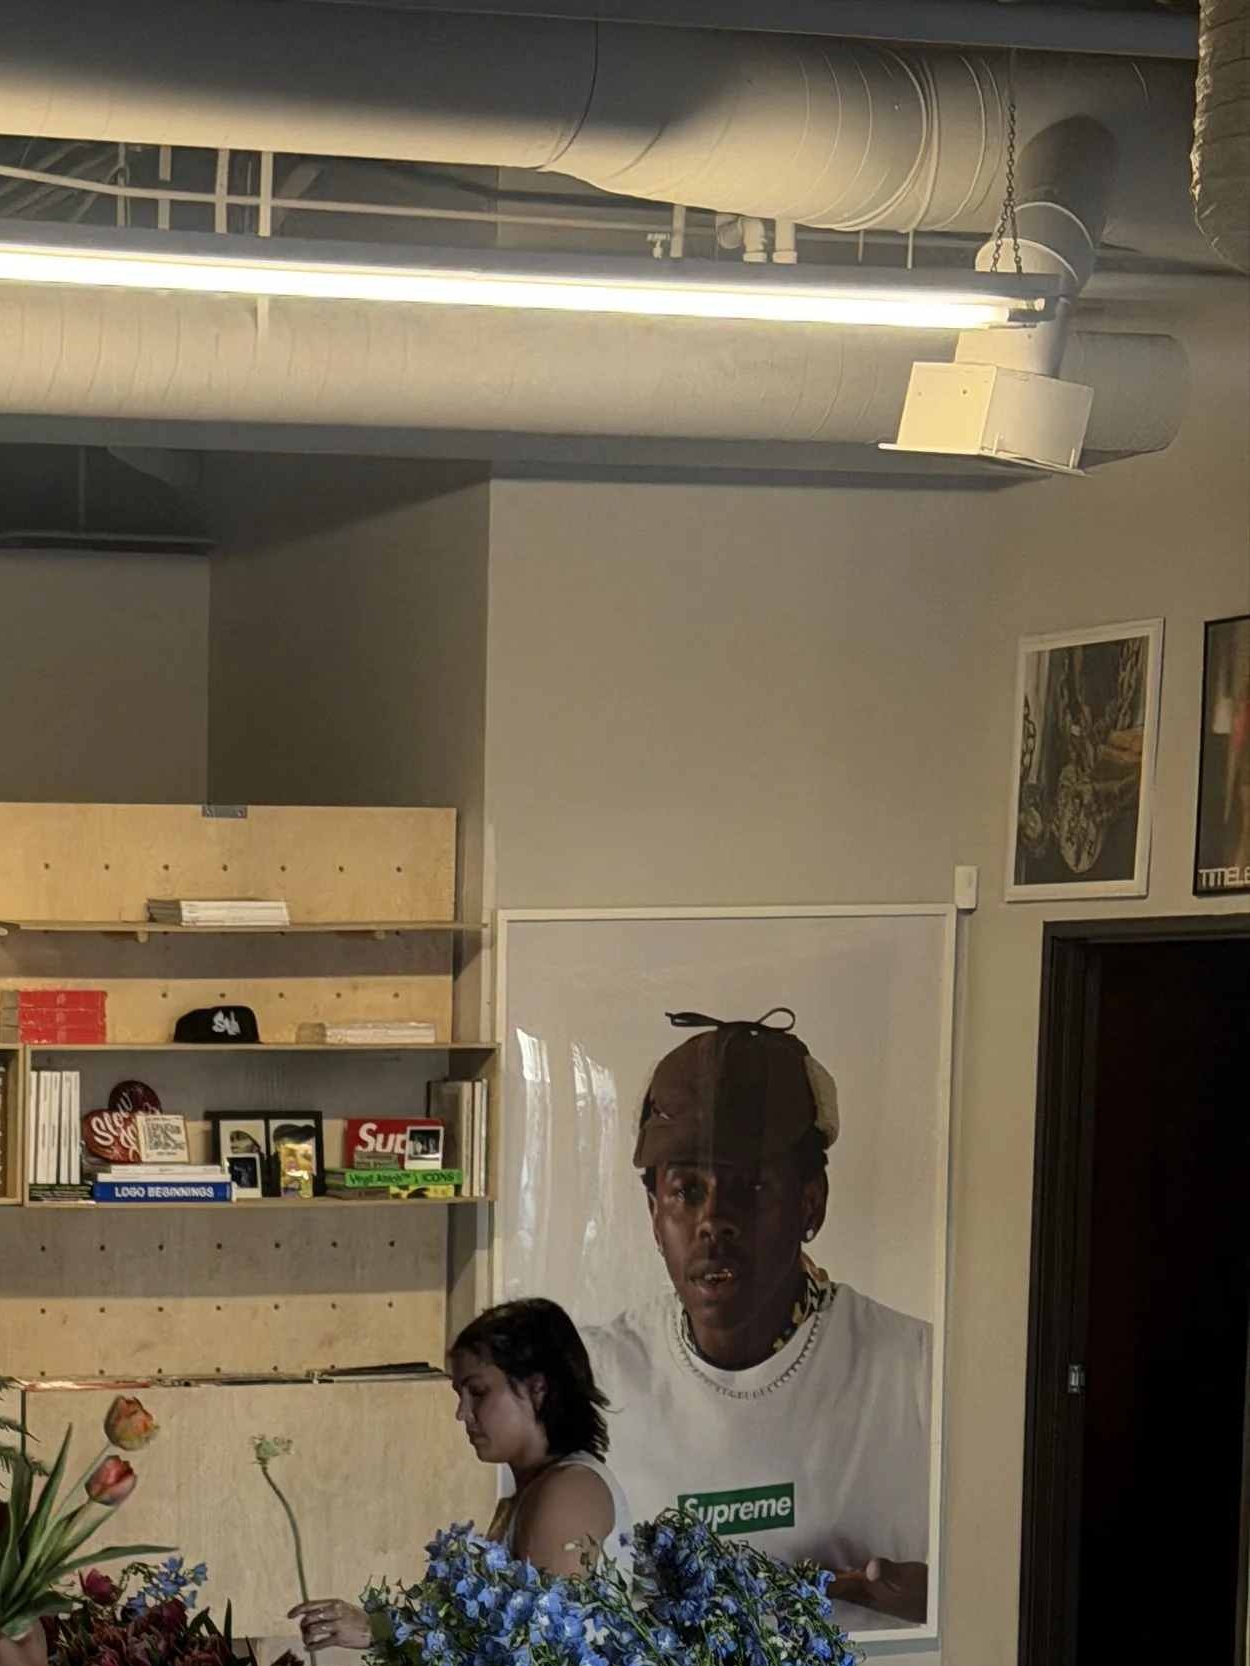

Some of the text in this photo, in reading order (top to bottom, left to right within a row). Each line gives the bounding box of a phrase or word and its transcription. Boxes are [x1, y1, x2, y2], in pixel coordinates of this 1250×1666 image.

[114, 1186, 214, 1198] LOGO BEGINNINGS
[684, 1496, 792, 1533] Supreme
